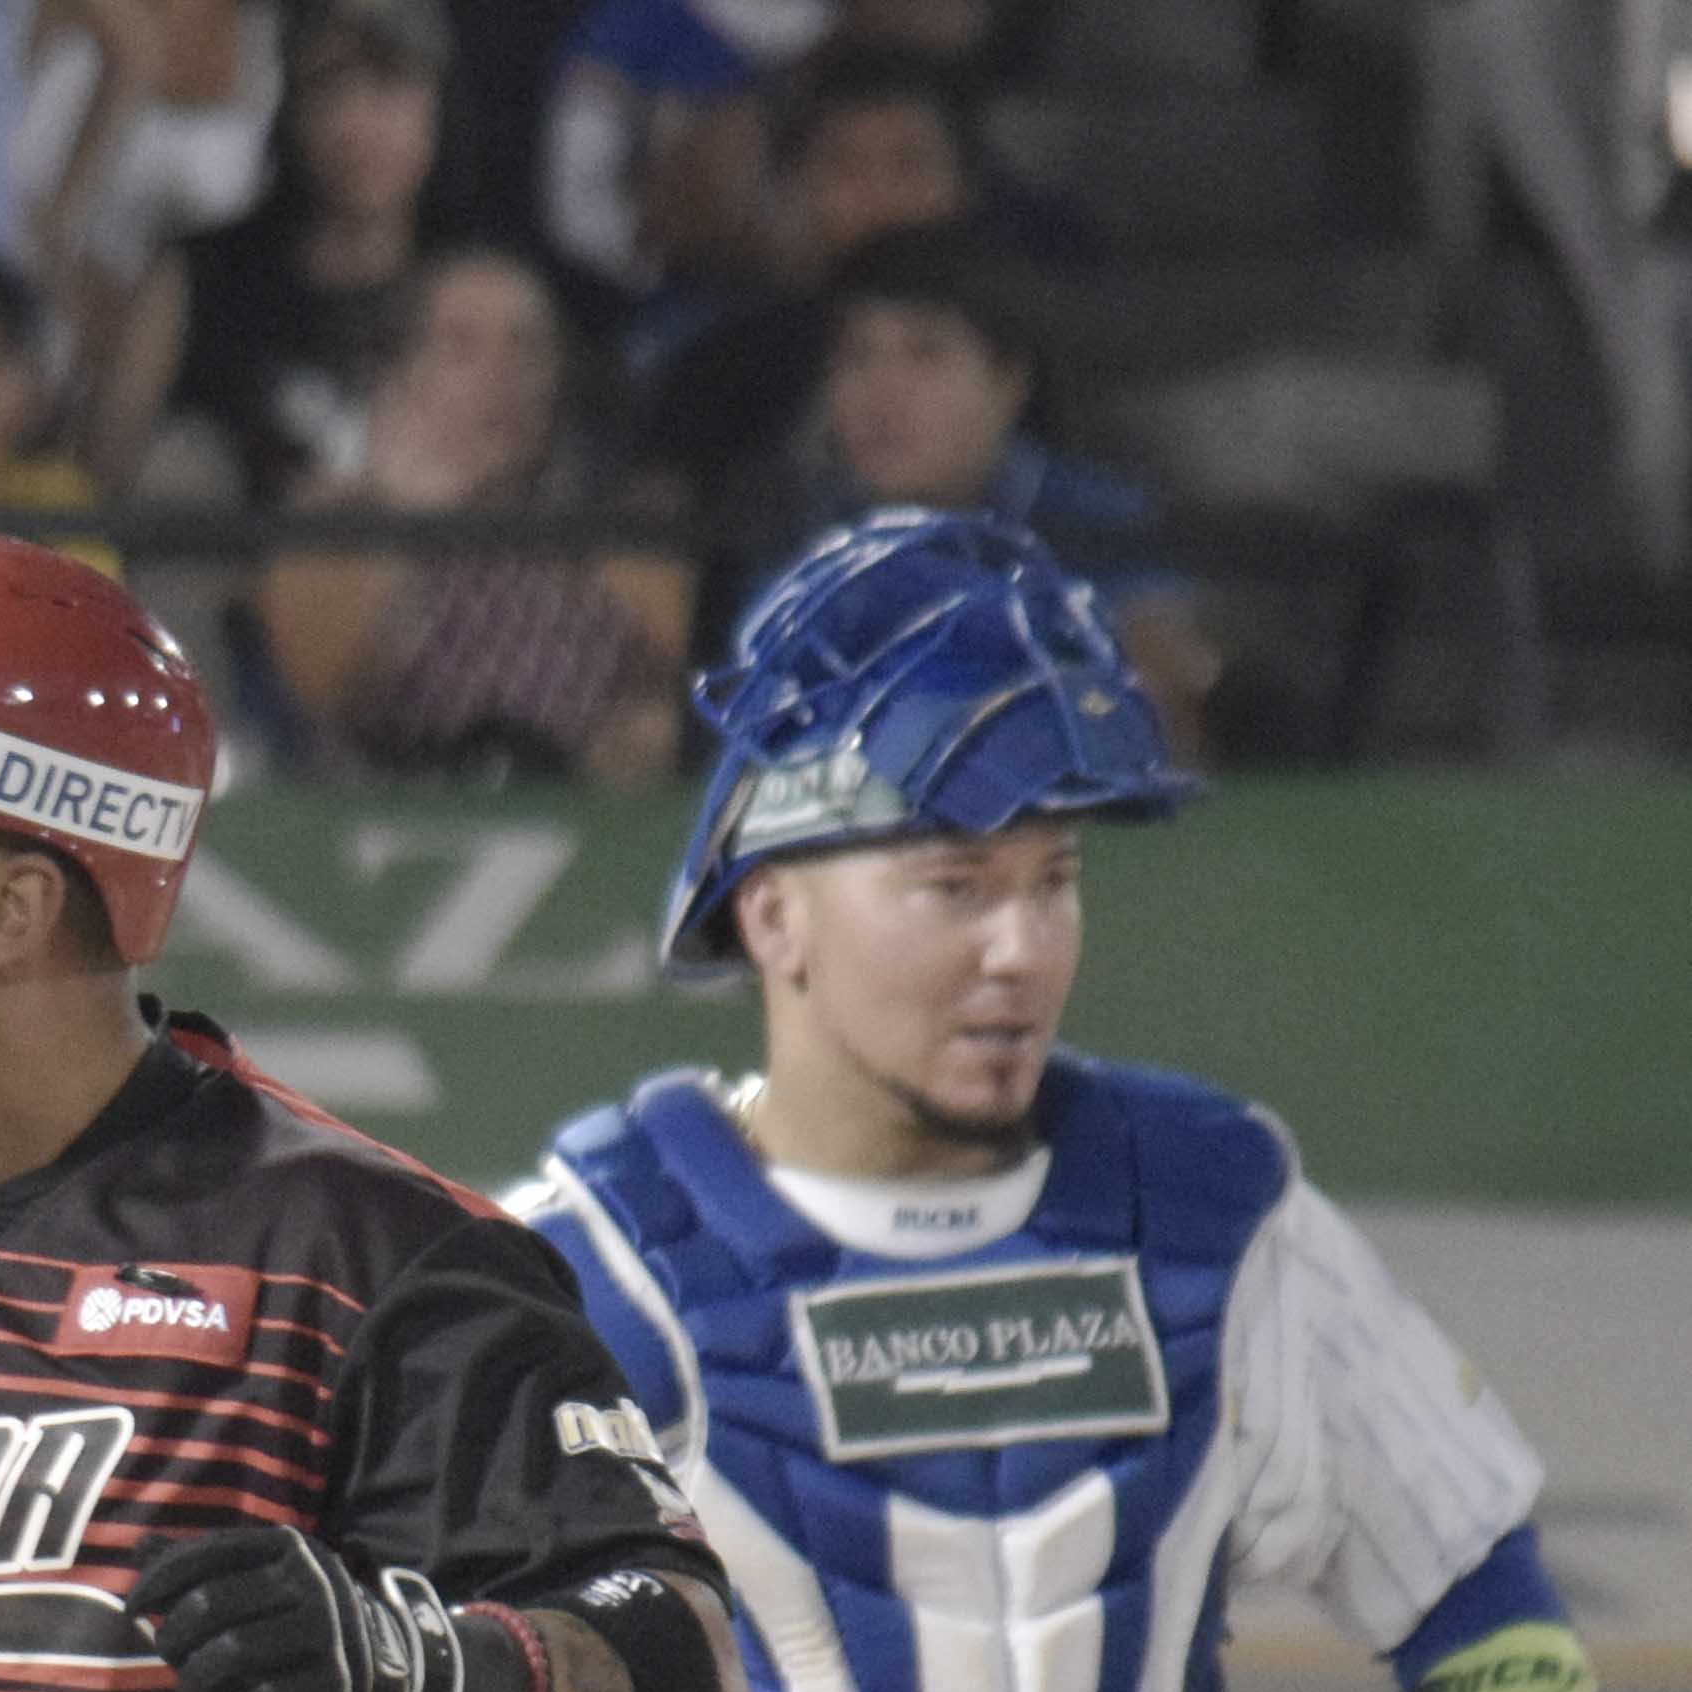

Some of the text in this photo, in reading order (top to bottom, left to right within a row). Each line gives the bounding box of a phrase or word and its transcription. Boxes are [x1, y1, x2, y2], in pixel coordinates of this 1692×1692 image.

[120, 1298, 231, 1332] PDVSA
[824, 1309, 1145, 1385] BANCO PLAZA
